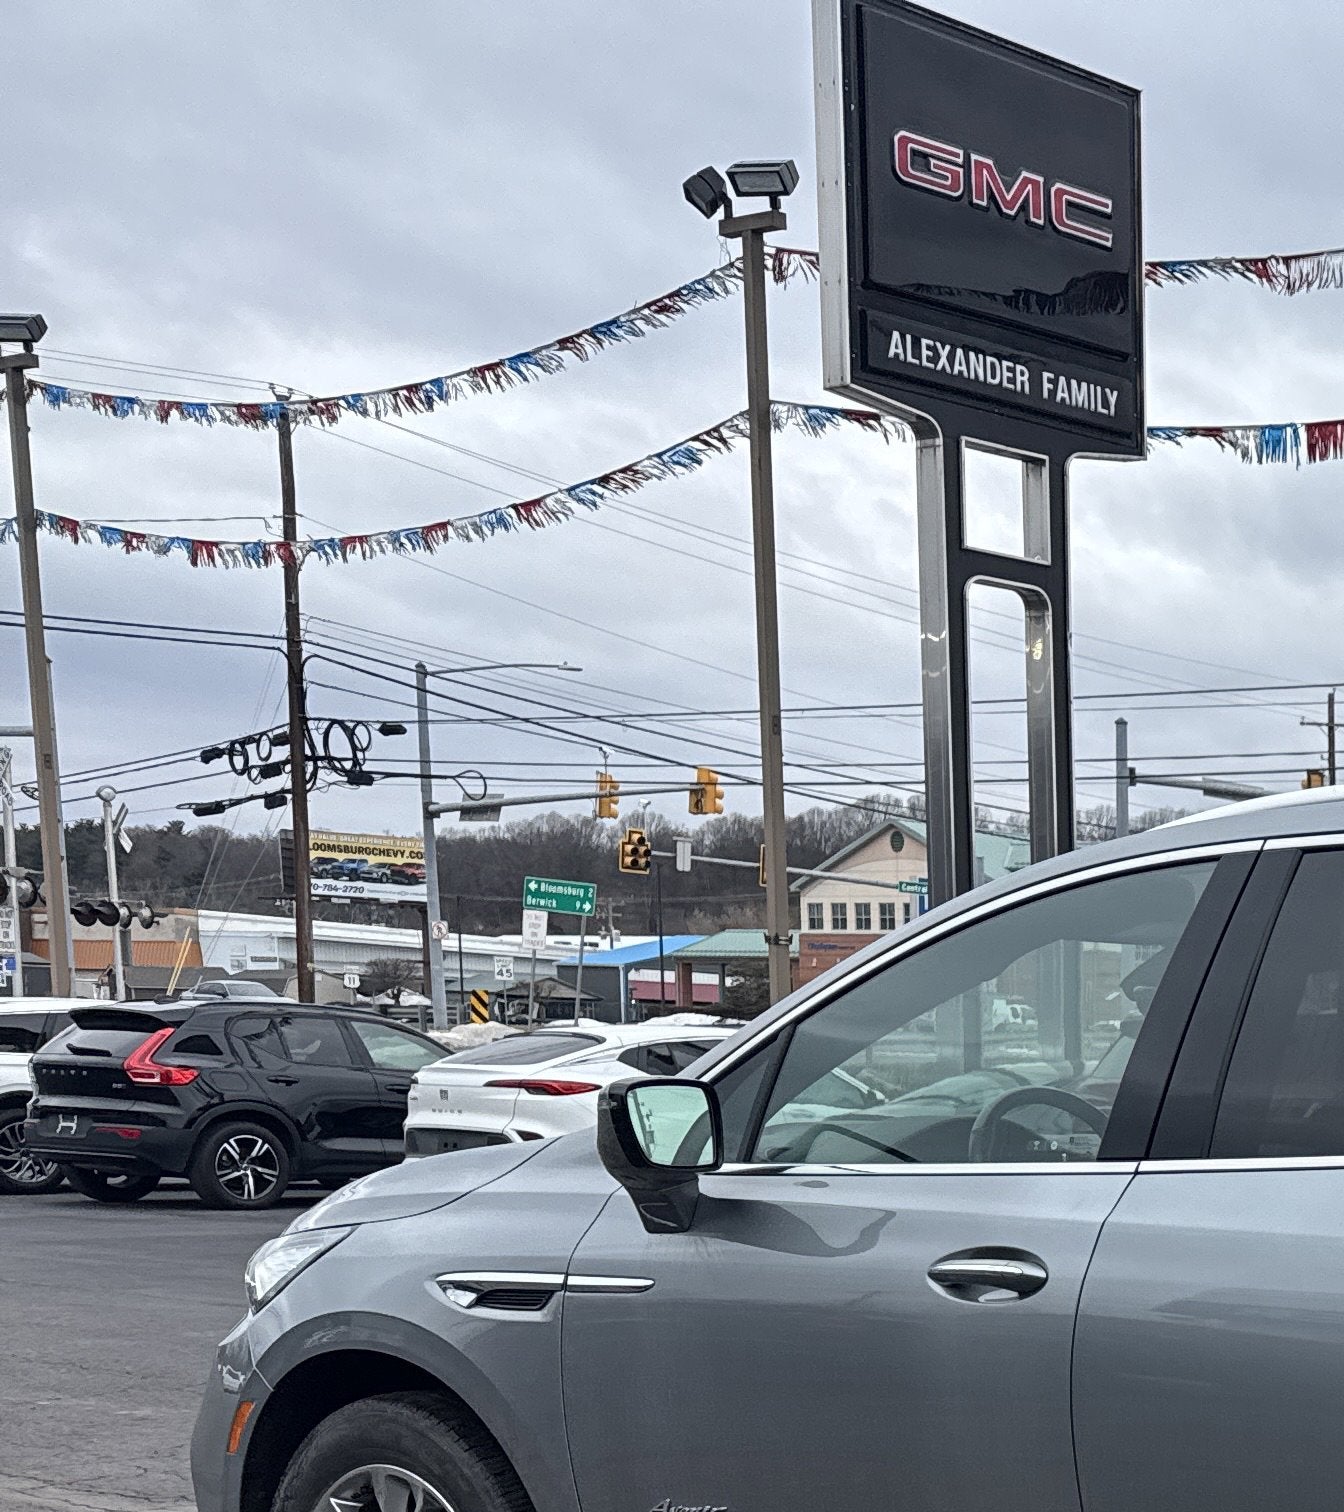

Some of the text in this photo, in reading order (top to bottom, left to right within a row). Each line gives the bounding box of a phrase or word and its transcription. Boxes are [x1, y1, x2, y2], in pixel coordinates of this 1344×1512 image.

[893, 130, 1113, 248] GMC
[888, 330, 1119, 418] ALEXANDER FAMILY
[309, 842, 424, 860] OOMSBURGCHEVY.CO
[311, 883, 364, 894] 0-784-2720
[540, 882, 594, 898] Bloomsburg 2
[526, 895, 557, 908] Berwick
[497, 968, 512, 978] 45
